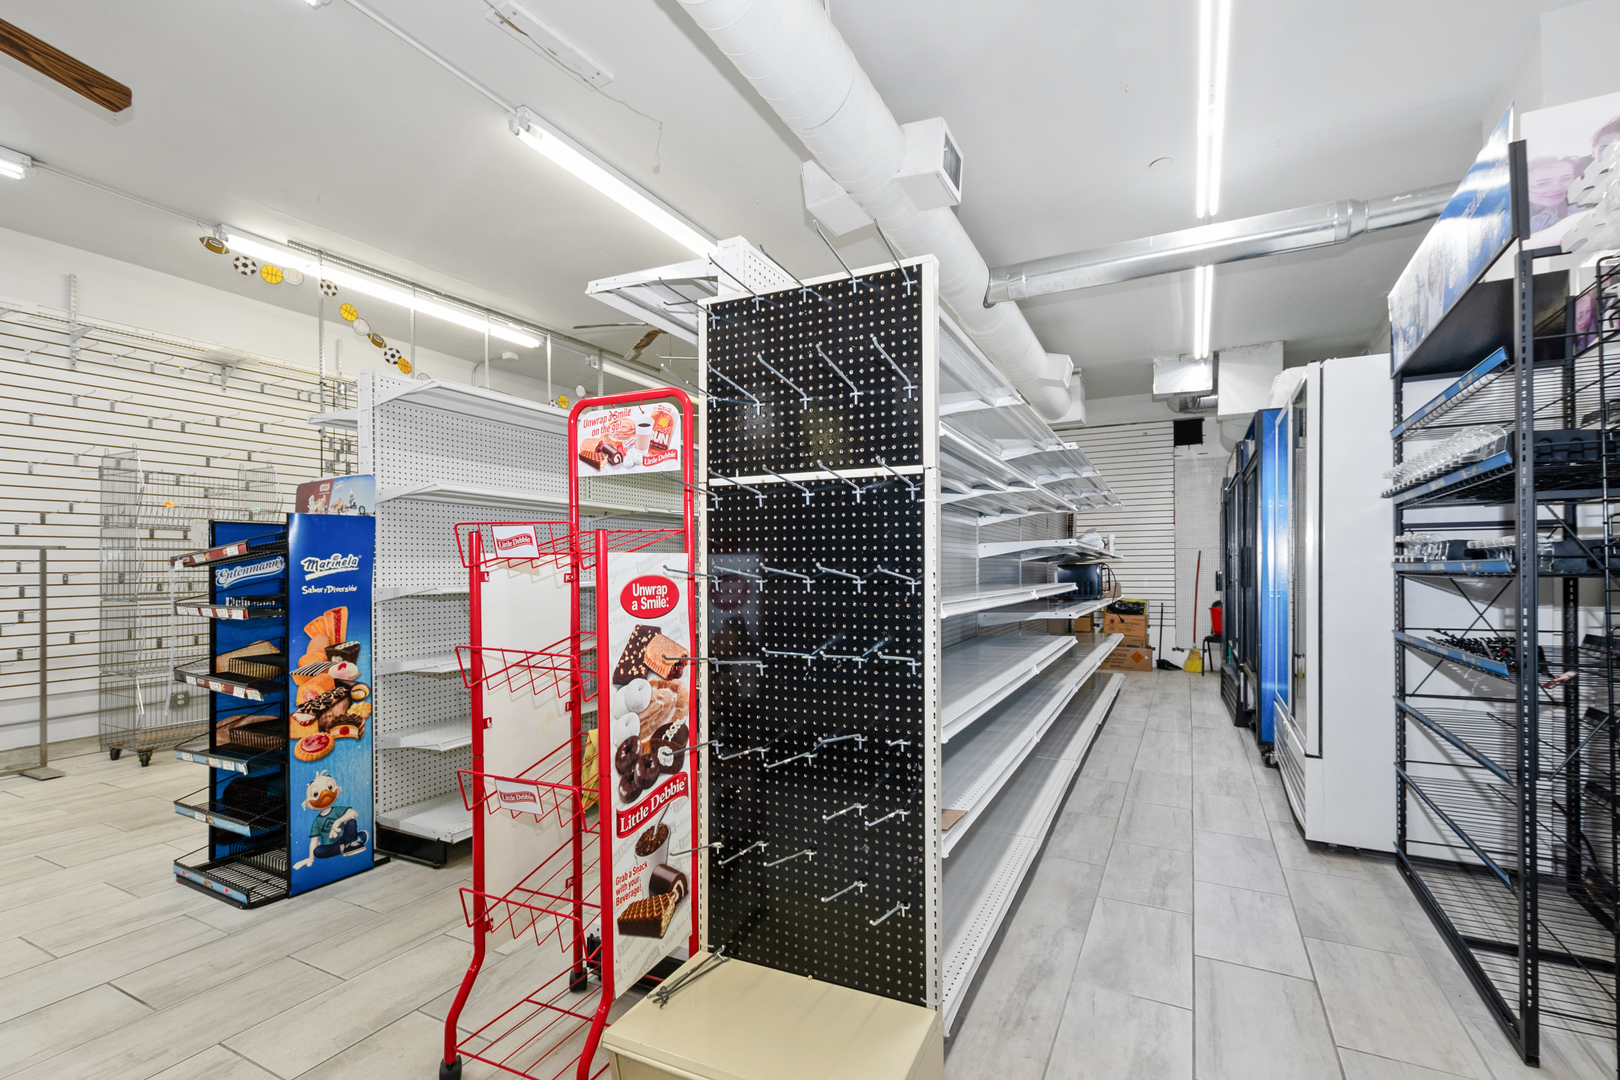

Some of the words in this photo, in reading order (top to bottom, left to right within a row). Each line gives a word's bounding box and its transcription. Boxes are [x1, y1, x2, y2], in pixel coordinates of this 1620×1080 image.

[583, 415, 608, 429] Unwrap
[613, 408, 632, 420] Smile
[591, 428, 599, 437] on
[600, 424, 610, 434] the
[611, 420, 622, 434] go!
[644, 456, 658, 466] Little
[658, 451, 676, 461] Debbie
[498, 539, 512, 548] Little
[512, 535, 531, 546] Debbie
[216, 556, 286, 587] Entenmann's
[301, 554, 359, 574] Marinela
[301, 585, 324, 595] Sabor
[327, 584, 358, 594] Diversión
[632, 583, 668, 597] Unwrap
[631, 600, 638, 611] a
[501, 793, 515, 801] Little
[515, 792, 534, 801] Debbie
[619, 805, 649, 833] Little
[650, 779, 685, 813] Debbie
[615, 871, 628, 886] Grab
[632, 860, 648, 876] Snack
[615, 882, 628, 896] with
[628, 876, 640, 891] your
[615, 882, 642, 907] Beverage!
